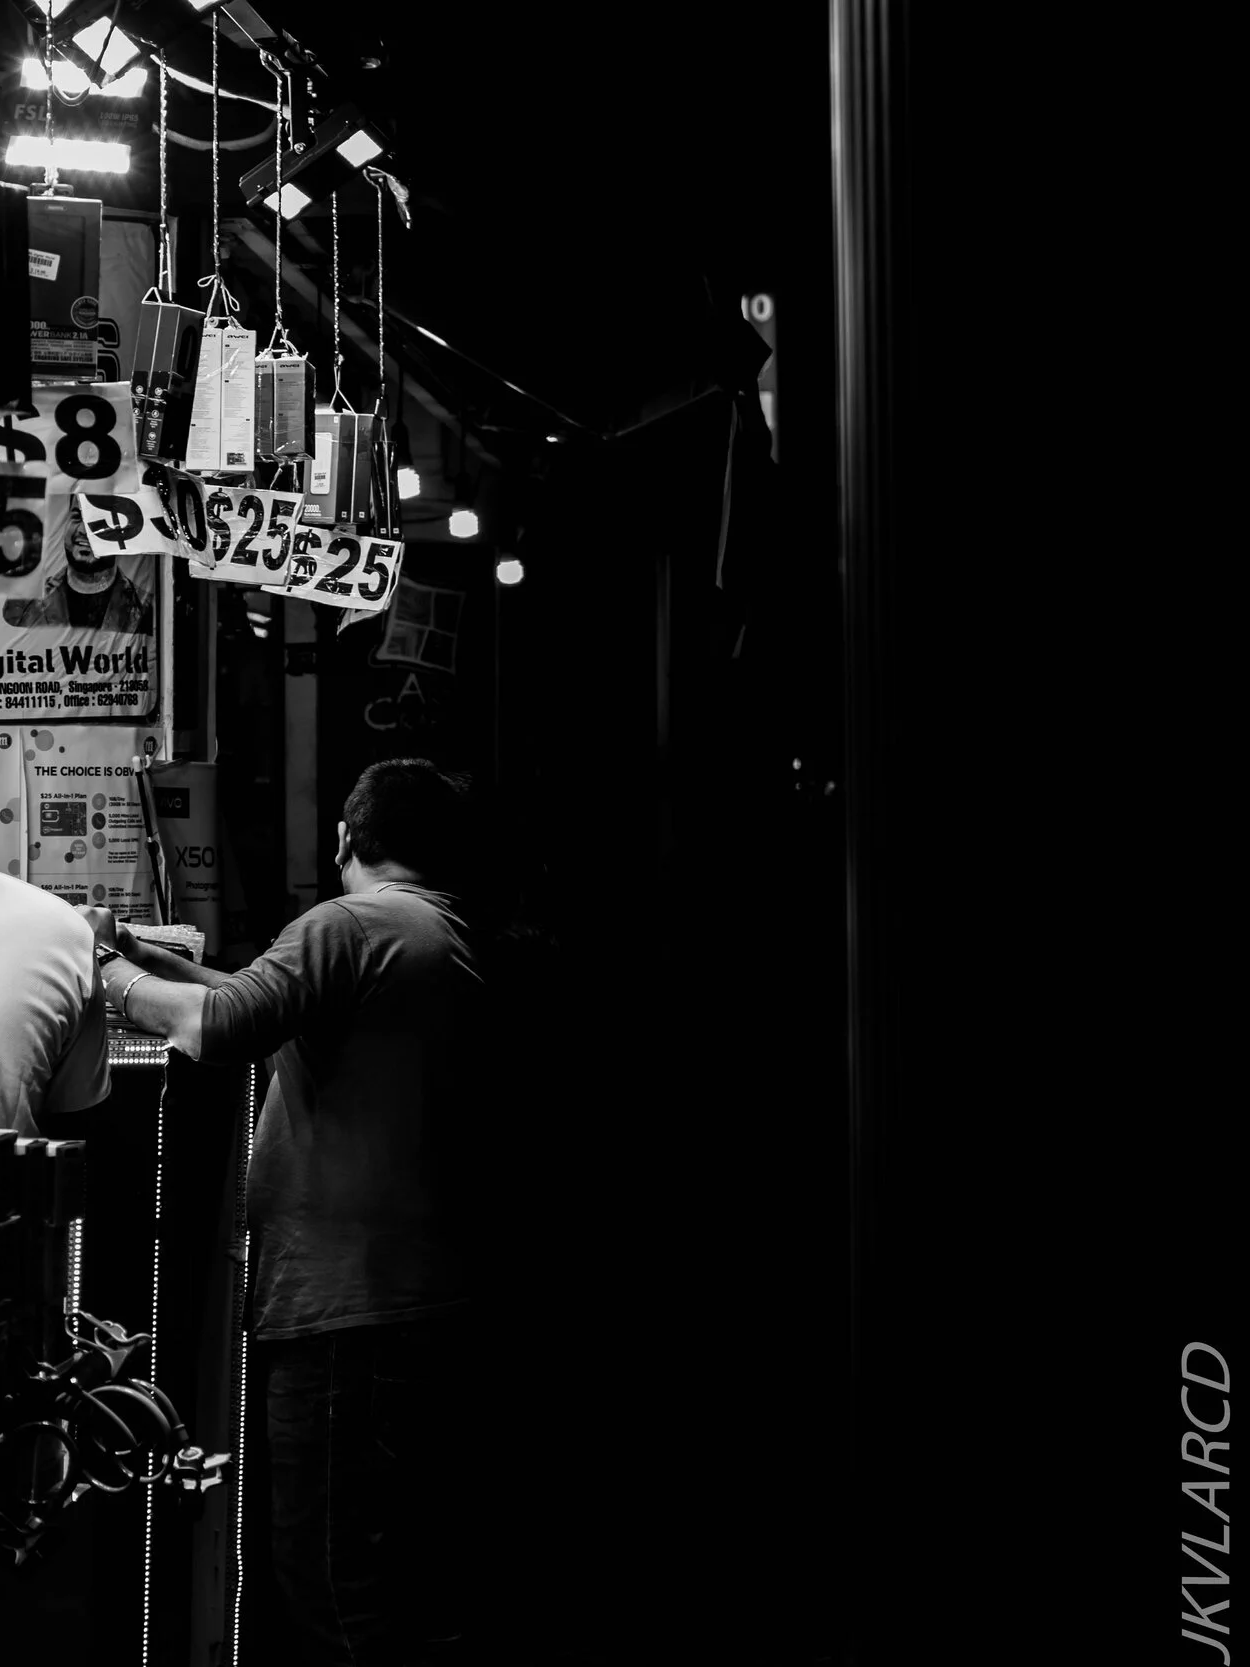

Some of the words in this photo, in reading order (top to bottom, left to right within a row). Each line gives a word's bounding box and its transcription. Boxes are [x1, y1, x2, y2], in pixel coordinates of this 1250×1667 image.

[14, 103, 48, 121] FSL
[206, 487, 297, 571] $25
[291, 528, 396, 602] $25
[59, 645, 149, 675] World
[36, 681, 63, 695] ROAD,
[68, 680, 113, 693] Singapore
[64, 695, 90, 708] Office
[34, 766, 58, 777] THE
[60, 766, 102, 777] CHOICE
[104, 766, 113, 777] IS
[115, 766, 135, 777] OBV
[175, 846, 216, 868] X50
